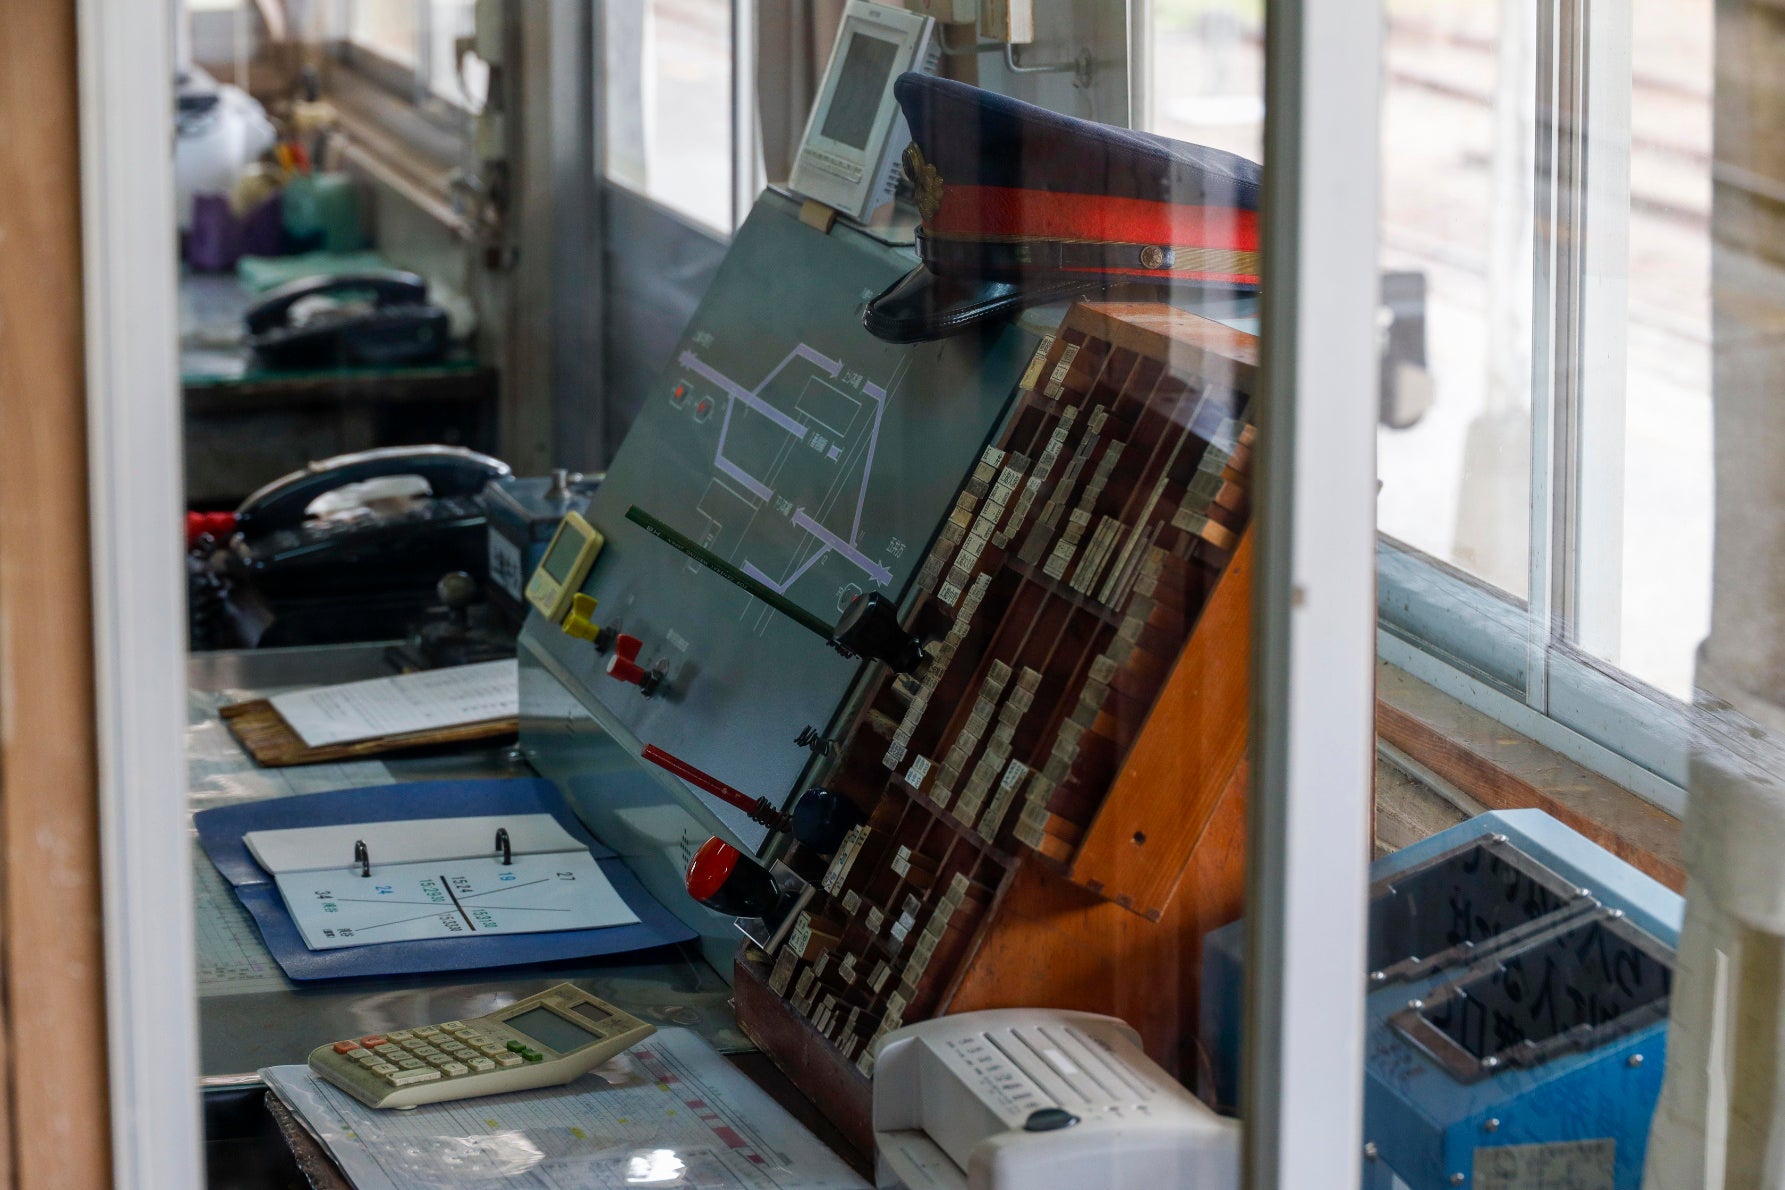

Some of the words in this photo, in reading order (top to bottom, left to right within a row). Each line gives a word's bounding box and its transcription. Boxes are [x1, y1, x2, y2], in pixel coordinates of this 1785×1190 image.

[498, 872, 516, 882] 19
[556, 871, 576, 881] 27
[452, 876, 475, 893] 15:24
[314, 890, 334, 899] 34
[375, 885, 394, 895] 24
